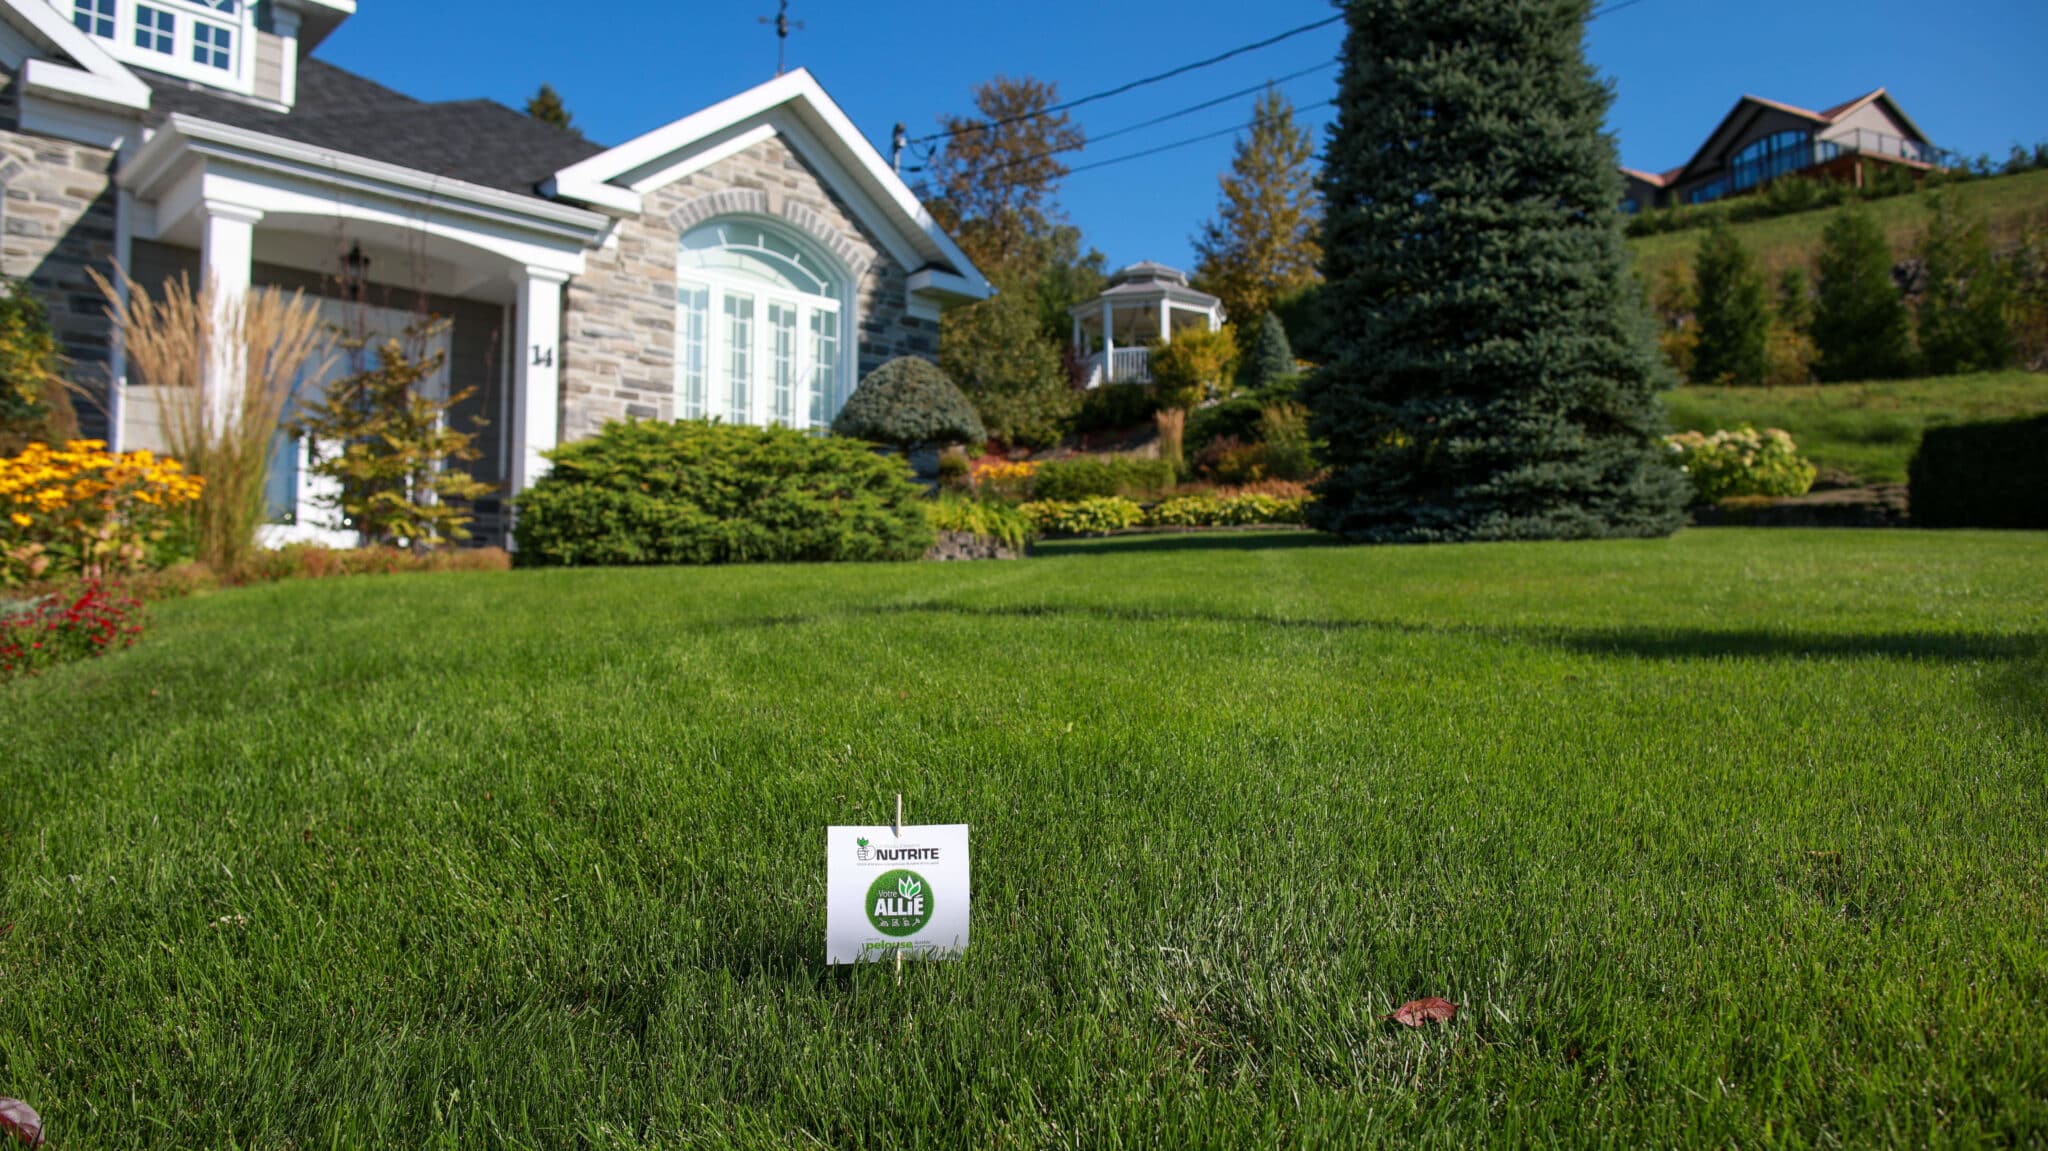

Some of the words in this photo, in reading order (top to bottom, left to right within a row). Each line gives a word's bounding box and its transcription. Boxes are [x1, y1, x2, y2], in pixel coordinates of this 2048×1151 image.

[532, 345, 552, 367] 14
[876, 848, 940, 861] NUTRITE
[878, 890, 898, 898] Votre
